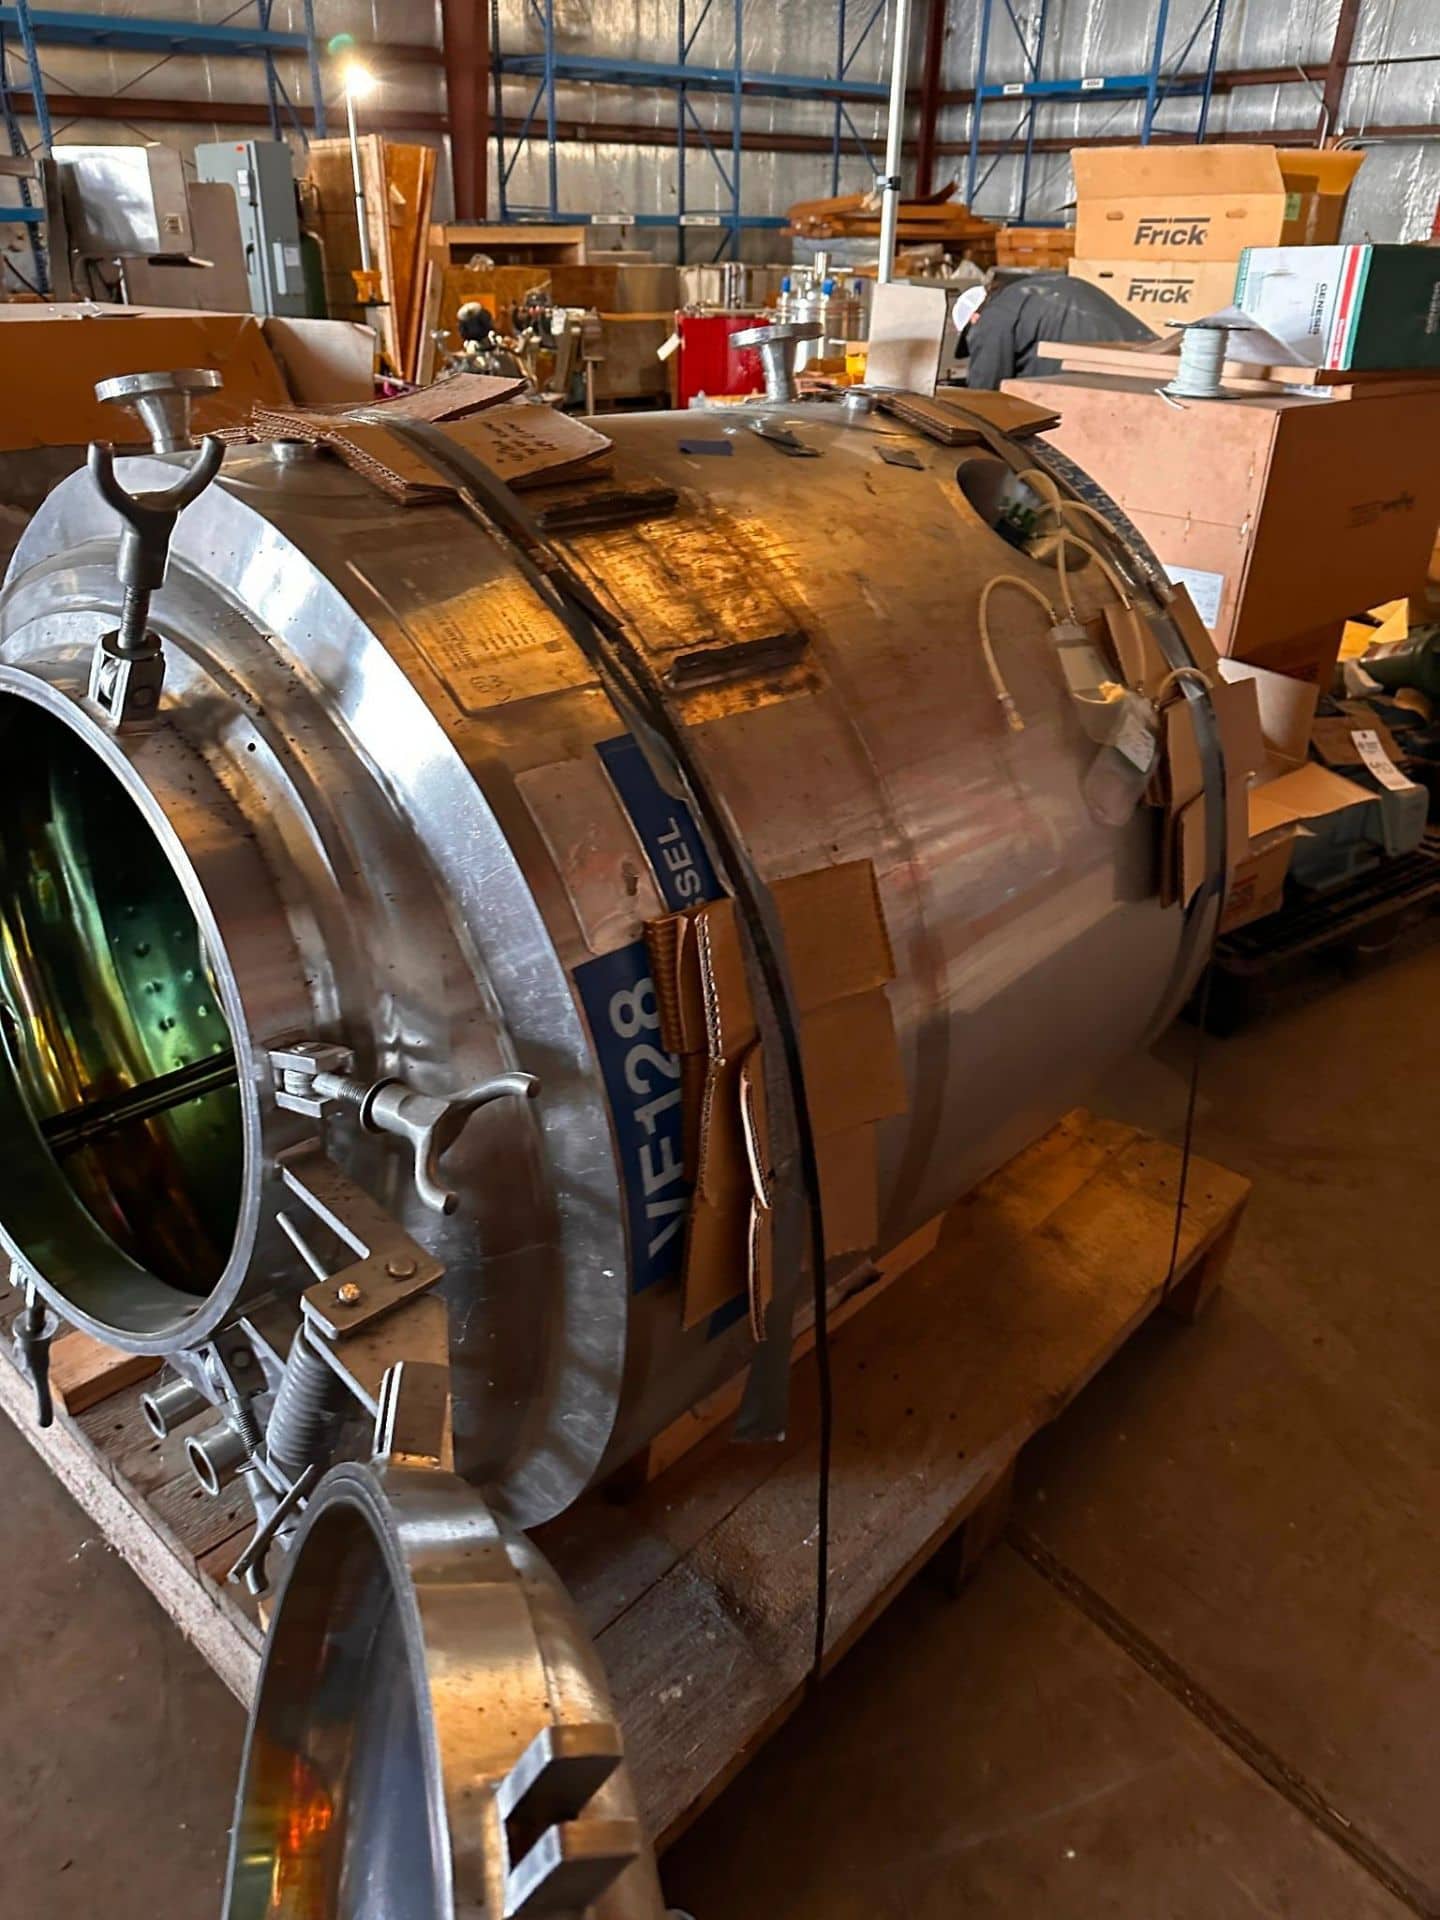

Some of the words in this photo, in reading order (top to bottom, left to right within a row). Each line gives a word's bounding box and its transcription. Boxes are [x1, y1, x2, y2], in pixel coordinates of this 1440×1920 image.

[1133, 224, 1207, 246] Frick
[1127, 284, 1191, 303] Frick
[656, 817, 705, 908] SEL
